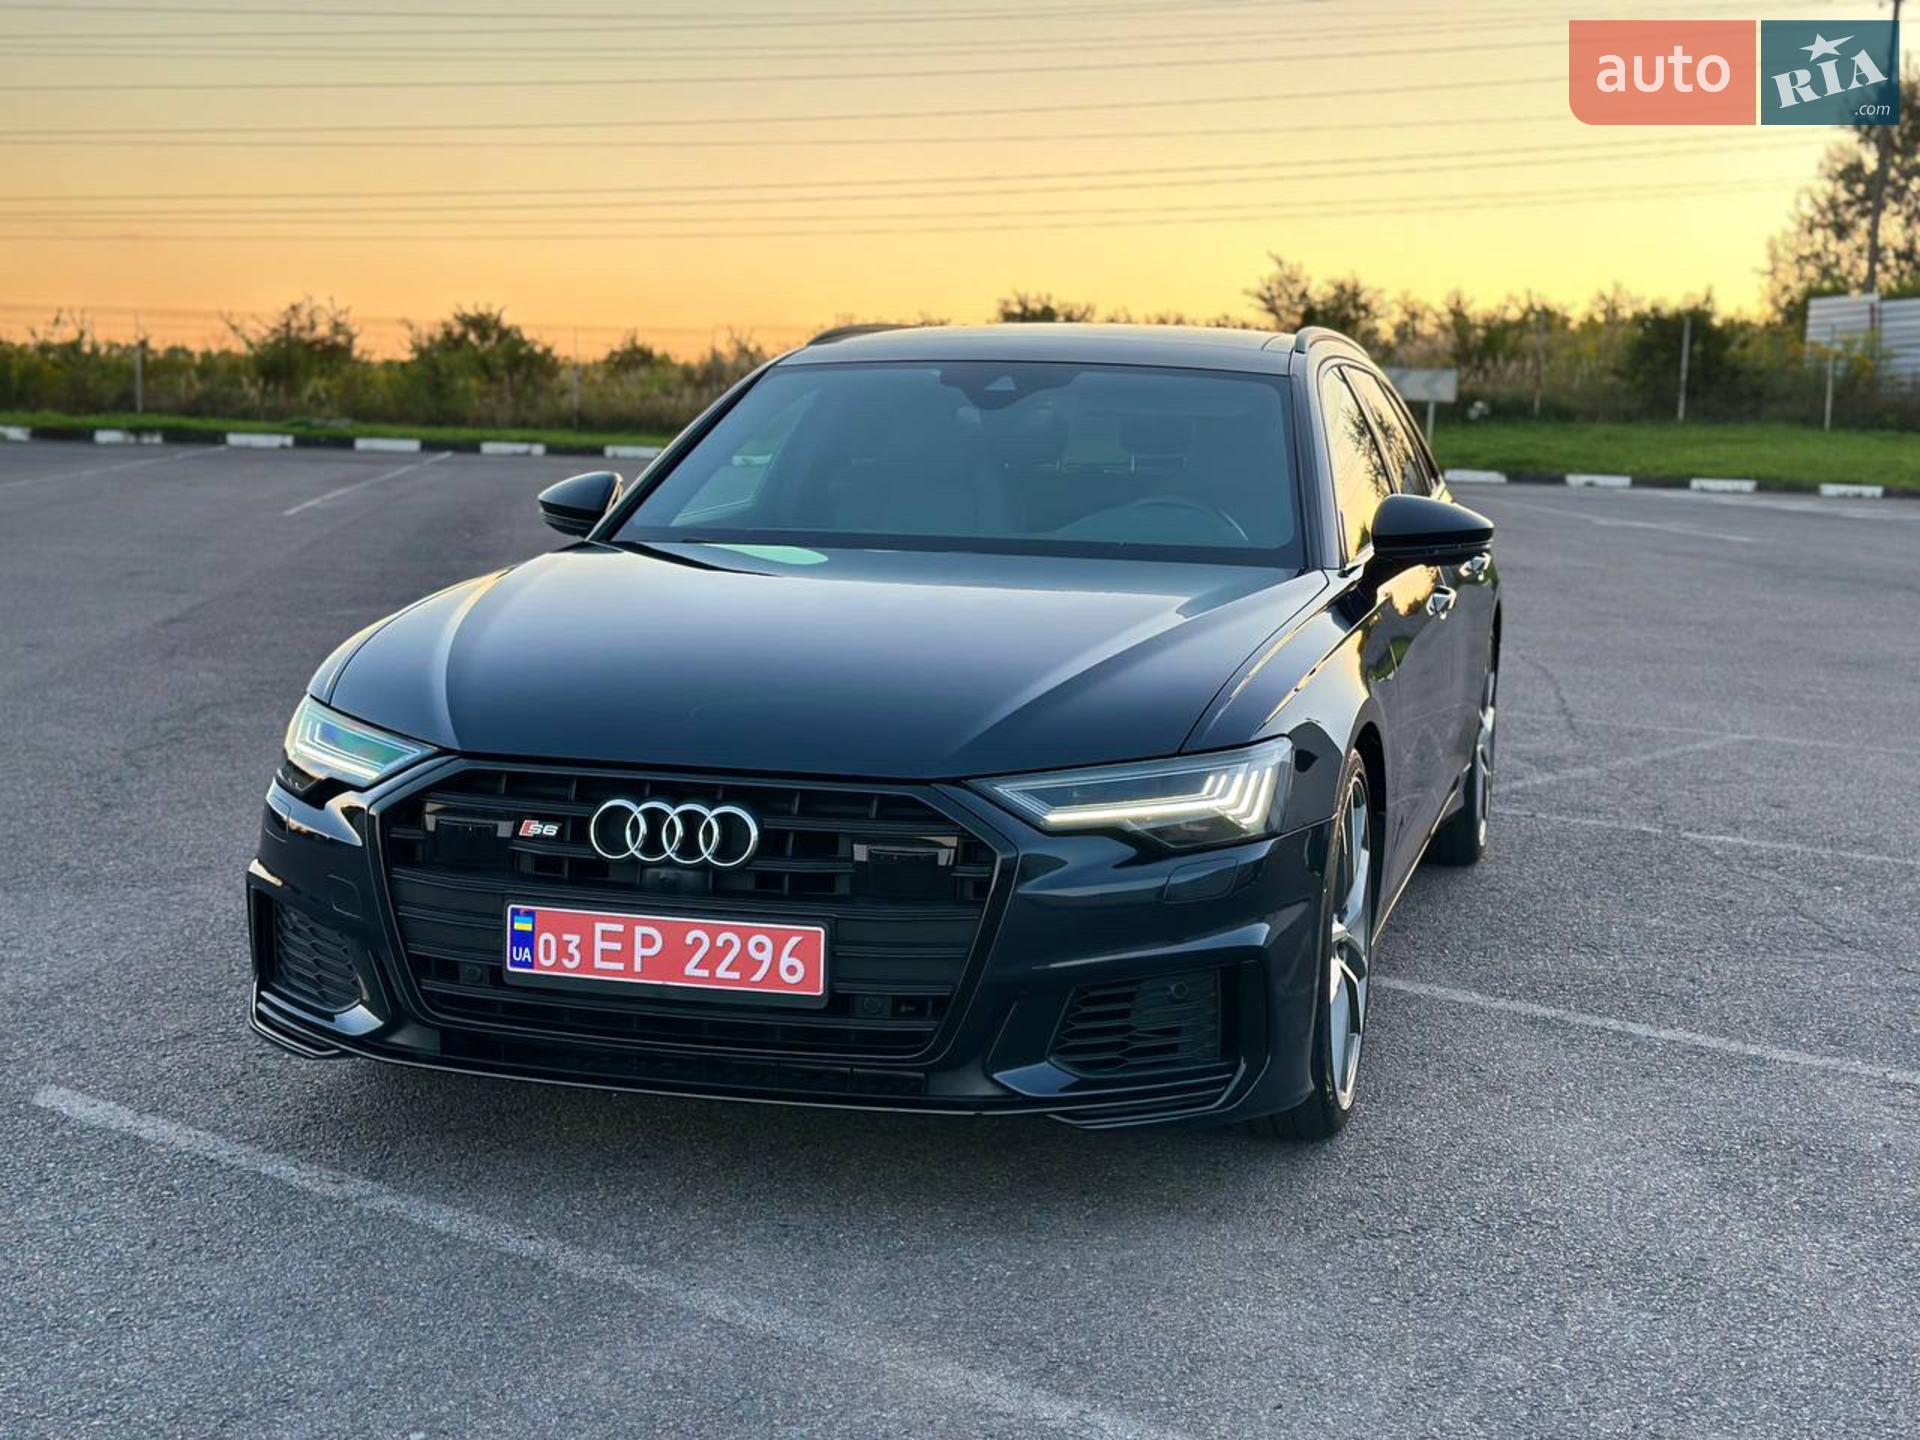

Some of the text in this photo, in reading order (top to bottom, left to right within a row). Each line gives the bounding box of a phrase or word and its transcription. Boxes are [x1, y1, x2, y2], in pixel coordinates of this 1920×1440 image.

[526, 823, 560, 837] S6
[512, 946, 532, 963] UA
[538, 922, 805, 985] 03 EP 2296
